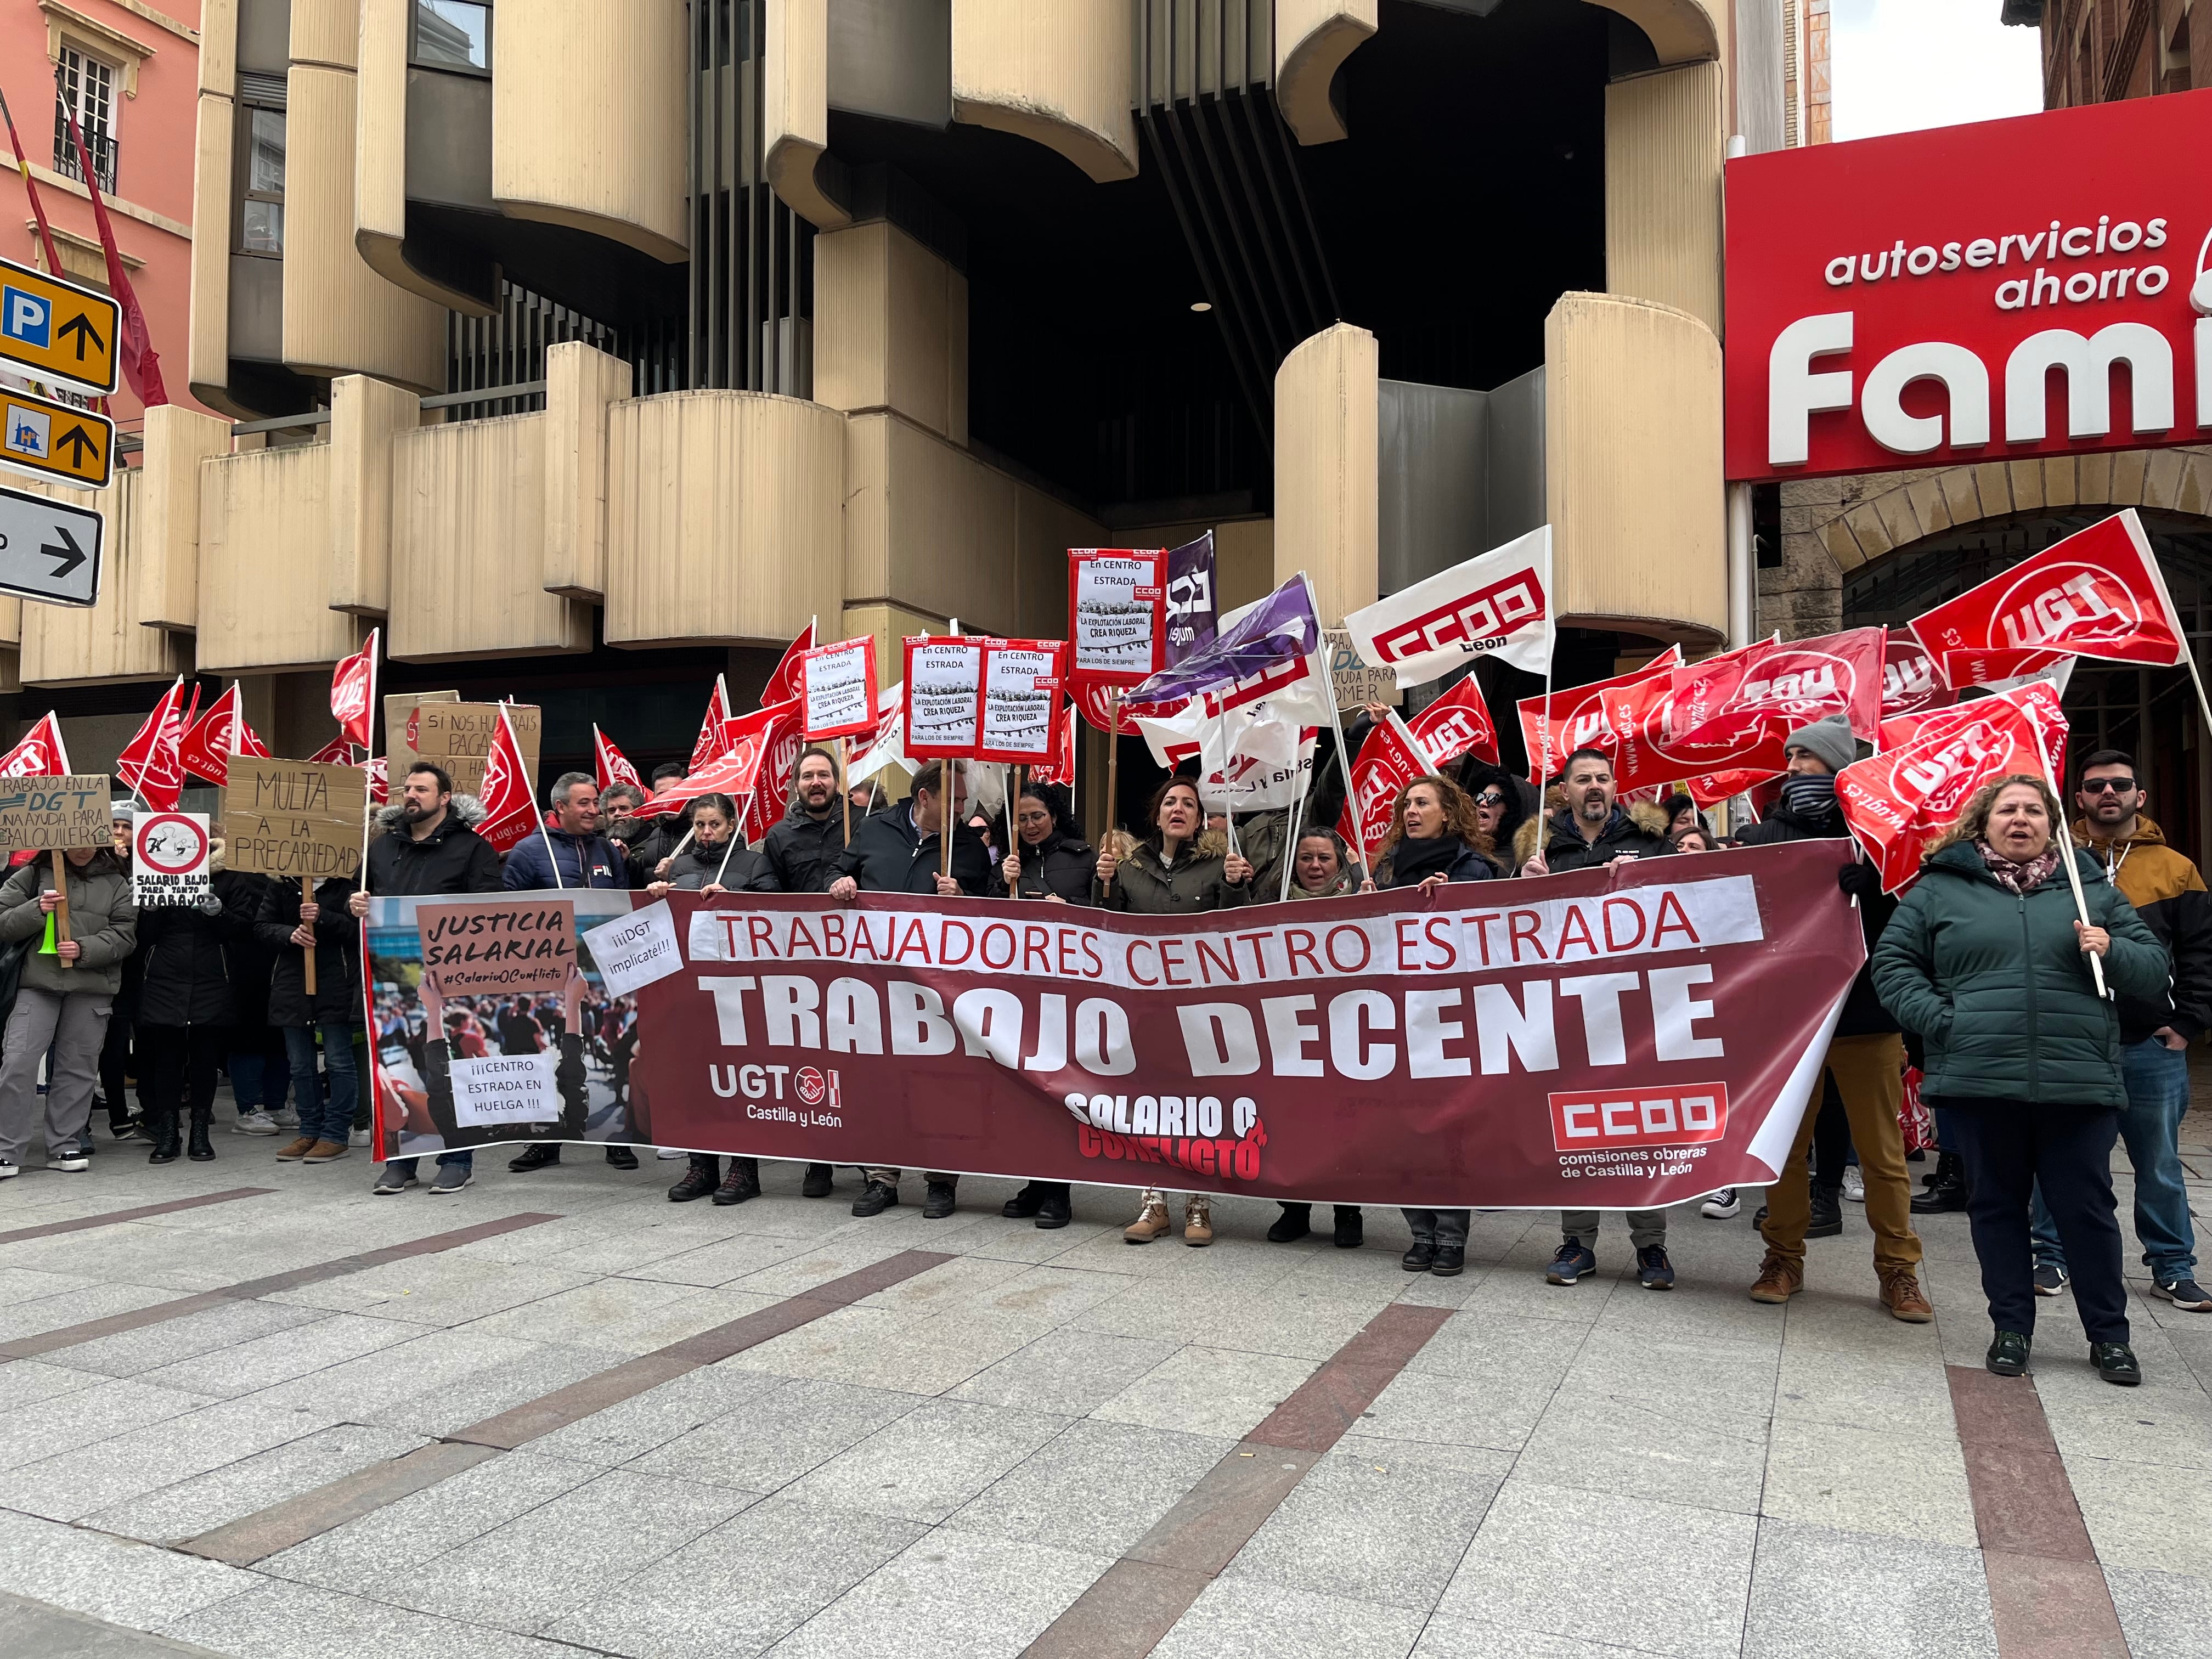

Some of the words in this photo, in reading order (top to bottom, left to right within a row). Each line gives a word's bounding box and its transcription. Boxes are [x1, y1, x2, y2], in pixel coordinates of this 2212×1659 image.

[1825, 215, 2167, 286] autoservicios
[1995, 265, 2169, 310] ahorro
[12, 295, 44, 336] P
[1090, 560, 1101, 568] En
[1104, 560, 1142, 569] CENTRO
[1094, 577, 1137, 585] ESTRADA
[2002, 571, 2118, 647] UGT
[1088, 617, 1121, 627] EXPLOTACIÓN
[1387, 582, 1536, 660] CCOO
[1090, 629, 1107, 637] CREA
[1109, 628, 1137, 637] RIQUEZA
[826, 649, 854, 660] CENTRO
[1011, 652, 1044, 661] CENTRO
[1333, 651, 1365, 671] DG
[820, 660, 851, 672] ESTRADA
[1001, 667, 1039, 675] ESTRADA
[1368, 669, 1397, 682] PARA
[818, 701, 831, 709] CREA
[832, 694, 854, 704] RIQUEZA
[922, 697, 951, 706] EXPLOTACIÓN
[952, 696, 972, 704] LABORAL
[1334, 684, 1380, 703] OMER
[924, 708, 939, 716] CREA
[940, 706, 965, 715] RIQUEZA
[995, 704, 1024, 712] EXPLOTACIÓN
[996, 714, 1011, 723] CREA
[1012, 713, 1037, 723] RIQUEZA
[451, 715, 475, 731] NOS
[449, 733, 492, 756] PAGA
[1418, 710, 1477, 763] UGT
[1617, 704, 1638, 777] www.ugt.es
[66, 776, 82, 790] EN
[87, 776, 104, 789] LA
[256, 770, 328, 811] MULTA
[29, 791, 98, 811] DGT
[25, 812, 66, 826] AYUDA
[74, 808, 103, 826] PARA
[12, 826, 91, 847] ALQUILER
[257, 817, 270, 835] A
[291, 819, 311, 838] LA
[235, 837, 360, 874] PRECARIEDAD
[137, 874, 180, 887] SALARIO
[185, 874, 208, 885] BAJO
[138, 895, 205, 906] TRABAJO
[428, 911, 563, 943] JUSTICIA
[611, 921, 651, 949] ¡¡¡DGT
[716, 914, 1103, 979] TRABAJADORES
[1126, 924, 1371, 986] CENTRO
[1396, 890, 1700, 971] ESTRADA
[426, 938, 574, 966] SALARIAL
[698, 975, 1137, 1076] TRABAJO
[1176, 964, 1724, 1080] DECENTE
[471, 1060, 534, 1076] ¡¡¡CENTRO
[468, 1081, 523, 1094] ESTRADA
[527, 1079, 541, 1091] EN
[710, 1064, 789, 1099] UGT
[475, 1099, 524, 1113] HUELGA
[527, 1098, 540, 1110] !!!
[1064, 1093, 1223, 1137] SALARIO
[1233, 1097, 1257, 1137] O
[747, 1104, 797, 1123] Castilla
[800, 1114, 808, 1127] y
[811, 1109, 842, 1128] León
[1563, 1096, 1716, 1138] CCOO
[1079, 1123, 1262, 1181] CONFLICTO
[1559, 1150, 1649, 1166] comisiones
[1653, 1145, 1708, 1160] obreras
[1561, 1166, 1581, 1178] de
[1584, 1163, 1643, 1177] Castilla
[1647, 1166, 1656, 1179] y
[1661, 1161, 1693, 1175] León
